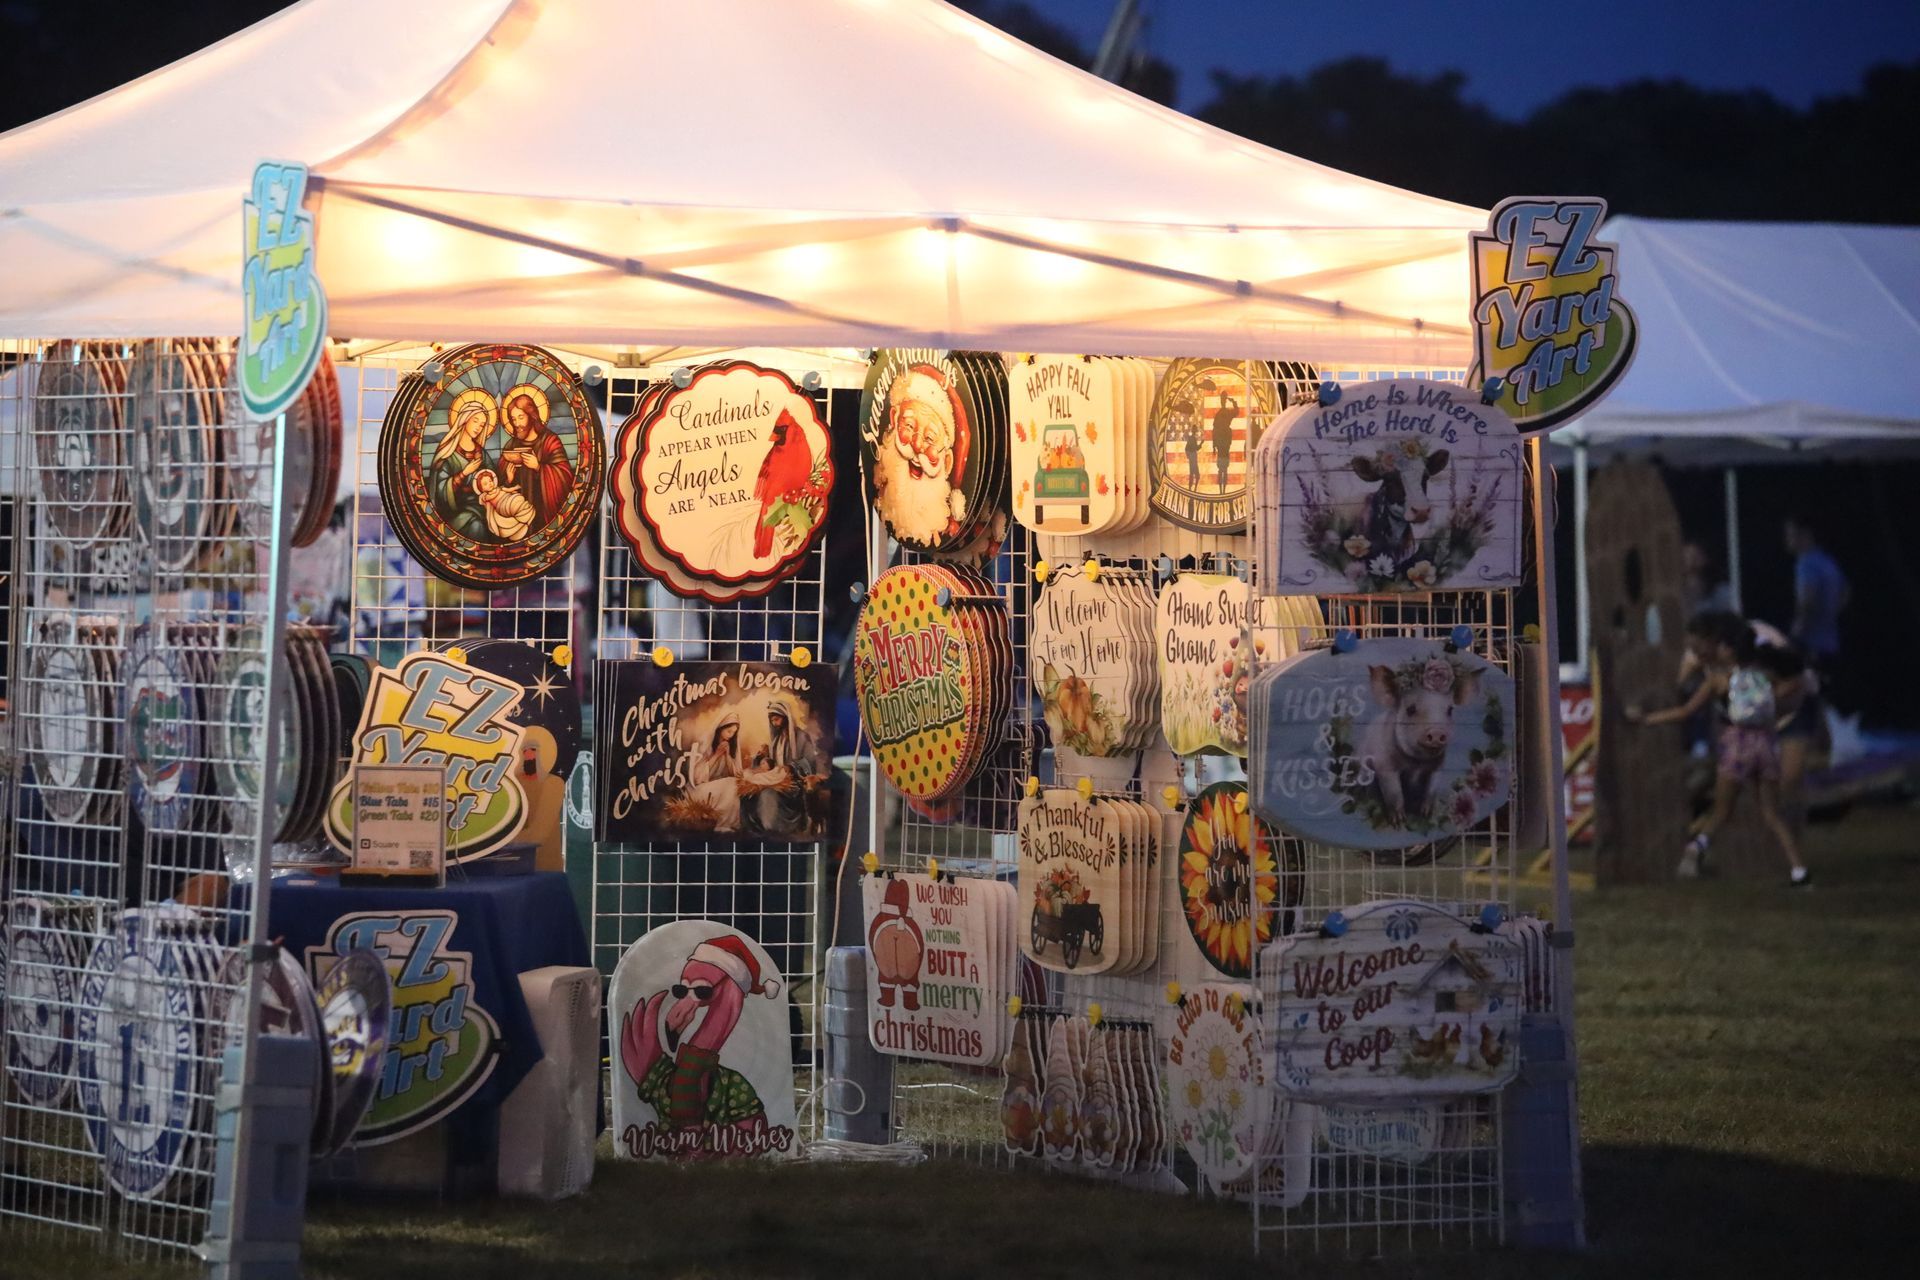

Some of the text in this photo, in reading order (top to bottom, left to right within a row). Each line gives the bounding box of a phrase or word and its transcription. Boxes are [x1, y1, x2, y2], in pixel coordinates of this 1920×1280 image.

[252, 162, 305, 250] EZ
[1496, 202, 1604, 283] EZ
[244, 247, 312, 322] Yard
[1477, 274, 1615, 349] Yard
[258, 306, 301, 384] Art
[1509, 330, 1597, 405] Art
[1026, 362, 1092, 403] HAPPY FALL
[669, 388, 774, 432] Cardinals
[1046, 395, 1073, 420] Y'ALL
[1313, 383, 1489, 440] Home Is Where
[1340, 408, 1459, 446] The Herd Is
[658, 428, 758, 459] APPEAR WHEN
[654, 450, 742, 499] Angels
[668, 488, 751, 516] ARE NEAR.
[1160, 485, 1190, 519] THANK
[1192, 499, 1211, 525] YOU
[1212, 501, 1232, 525] FOR
[1048, 588, 1109, 636] Welcome
[1167, 591, 1214, 629] Home
[868, 622, 947, 695] MERRY
[1060, 638, 1077, 662] our
[1079, 626, 1122, 675] Home
[1165, 627, 1218, 667] Gnome
[402, 658, 520, 744] EZ
[622, 663, 811, 748] Christmas began
[864, 671, 965, 747] CHRISTMAS
[1281, 684, 1367, 721] HOGS
[627, 716, 683, 768] with
[1313, 722, 1336, 753] &
[612, 742, 703, 820] Christ
[1271, 755, 1376, 799] KISSES
[359, 809, 387, 822] Green
[390, 810, 414, 821] Tabs
[385, 796, 409, 807] Tabs
[1030, 801, 1104, 843] Thankful
[1034, 831, 1102, 874] & Blessed
[1205, 863, 1228, 887] are
[335, 916, 453, 988] EZ
[925, 928, 961, 945] NOTHING
[926, 948, 979, 984] BUTT A
[1294, 941, 1426, 999] Welcome
[921, 981, 983, 1020] merry
[1317, 980, 1399, 1034] to our
[873, 1009, 983, 1059] christmas
[1170, 1034, 1184, 1066] BE
[1177, 992, 1202, 1038] KIND
[1204, 987, 1219, 1012] TO
[1323, 1025, 1396, 1072] Coop
[625, 1119, 792, 1156] Warm Wishes
